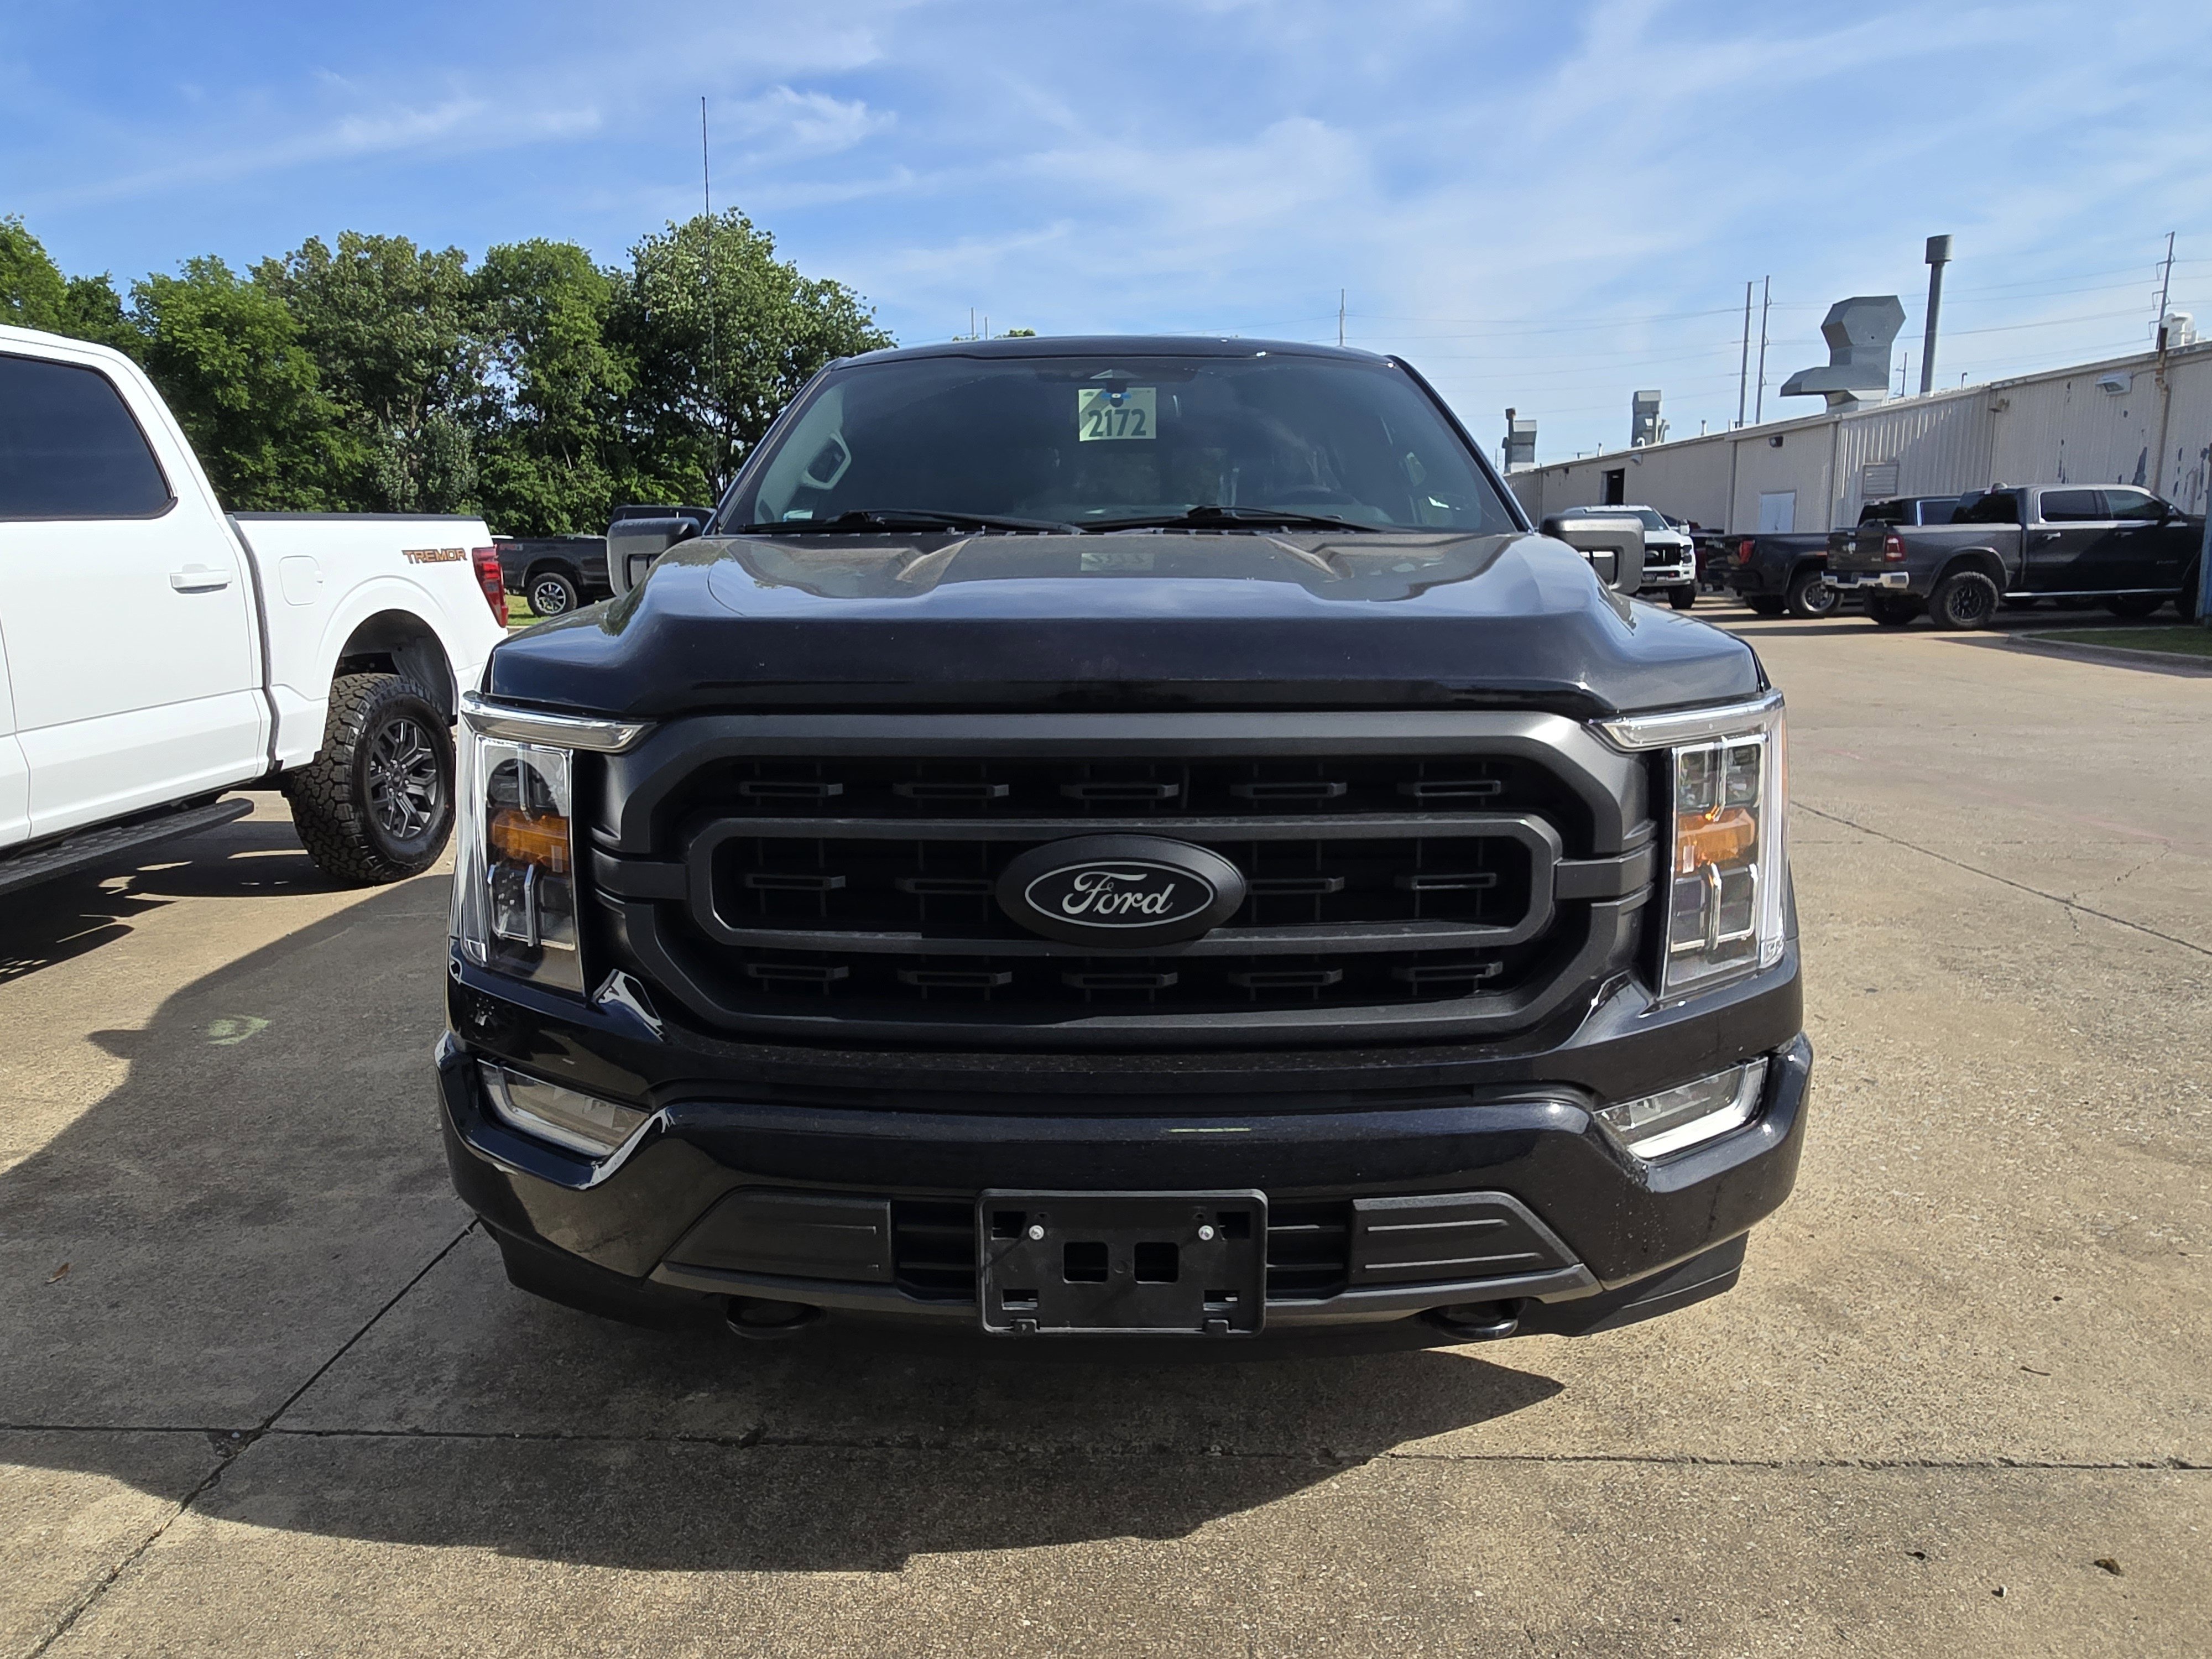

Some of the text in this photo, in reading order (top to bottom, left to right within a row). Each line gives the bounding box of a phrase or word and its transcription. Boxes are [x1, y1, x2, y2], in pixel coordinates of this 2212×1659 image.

[1088, 409, 1146, 437] 2172
[401, 547, 467, 564] TREMOR
[1062, 871, 1173, 915] Ford
